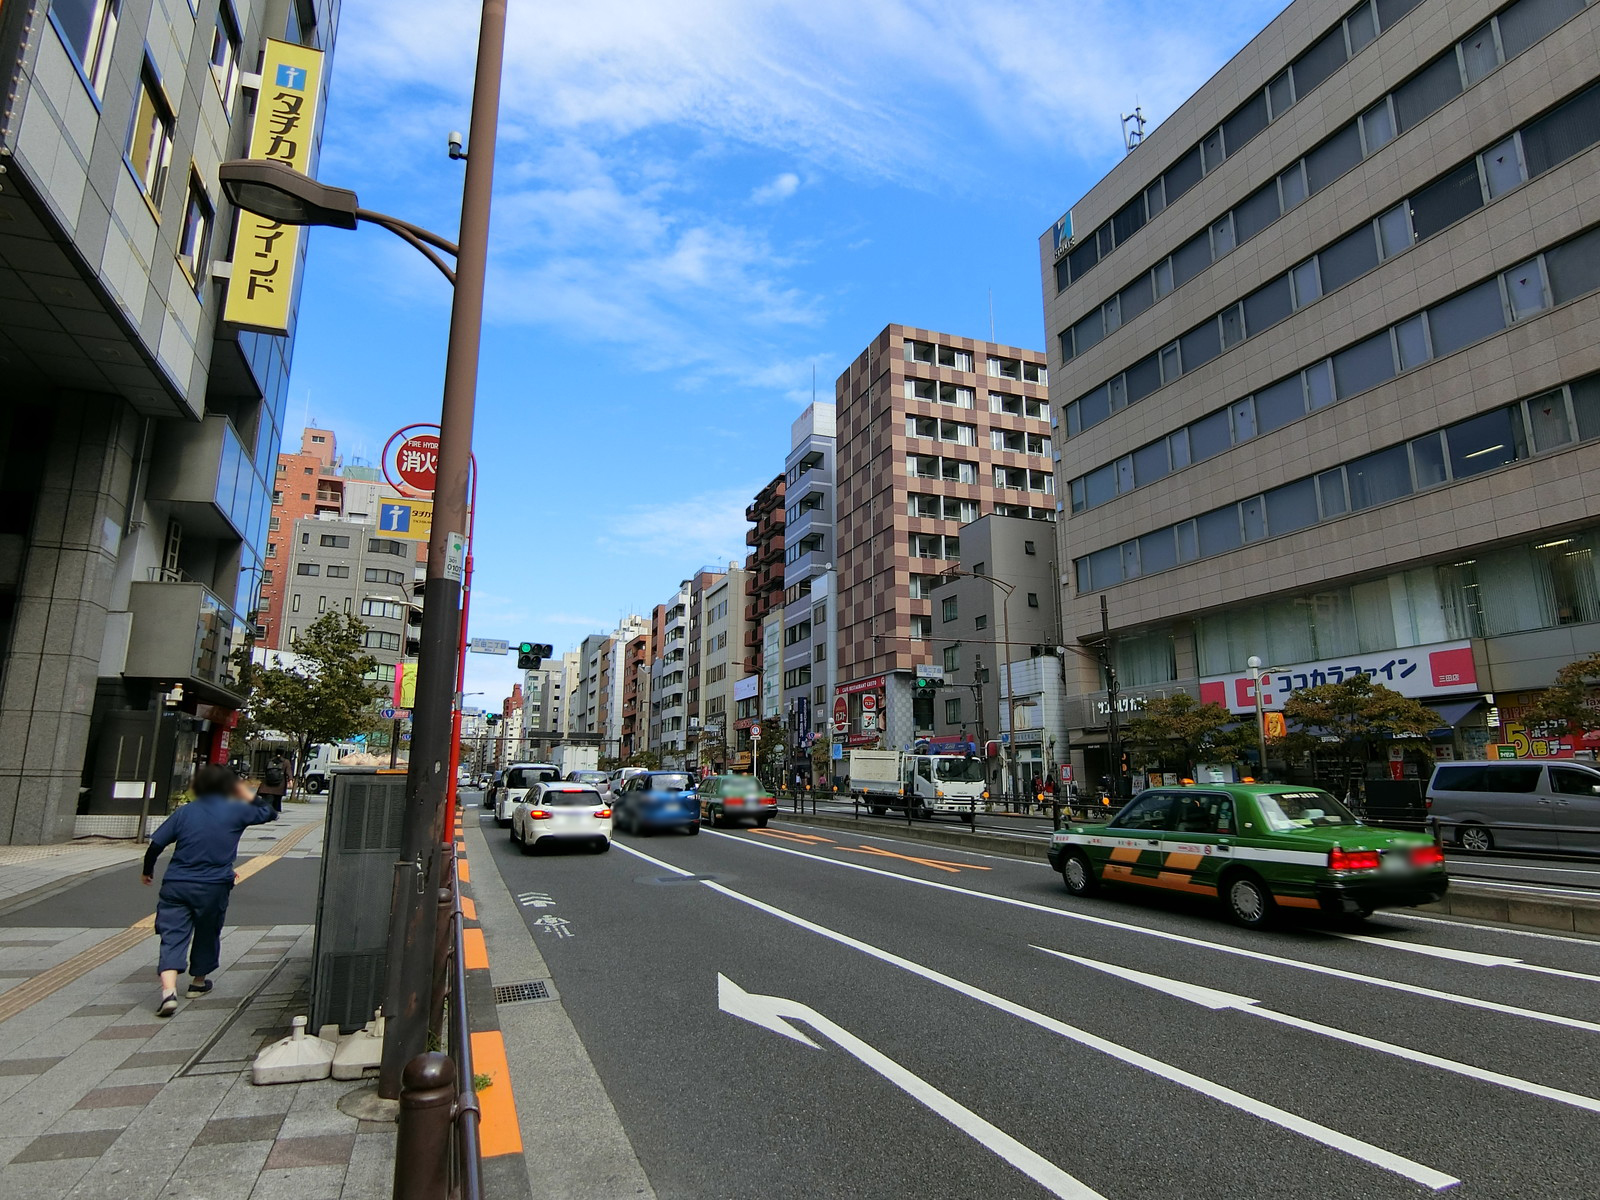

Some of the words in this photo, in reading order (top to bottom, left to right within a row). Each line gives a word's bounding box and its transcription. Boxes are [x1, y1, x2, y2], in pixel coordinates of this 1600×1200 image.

[247, 92, 304, 300] タチカインド
[423, 441, 439, 449] HYDR
[402, 450, 438, 474] 消火
[411, 510, 432, 518] タチカ
[474, 640, 506, 649] 三田二丁目
[1278, 658, 1417, 692] ココカラファイン
[1439, 674, 1460, 683] 三田店
[835, 711, 846, 722] ガスト
